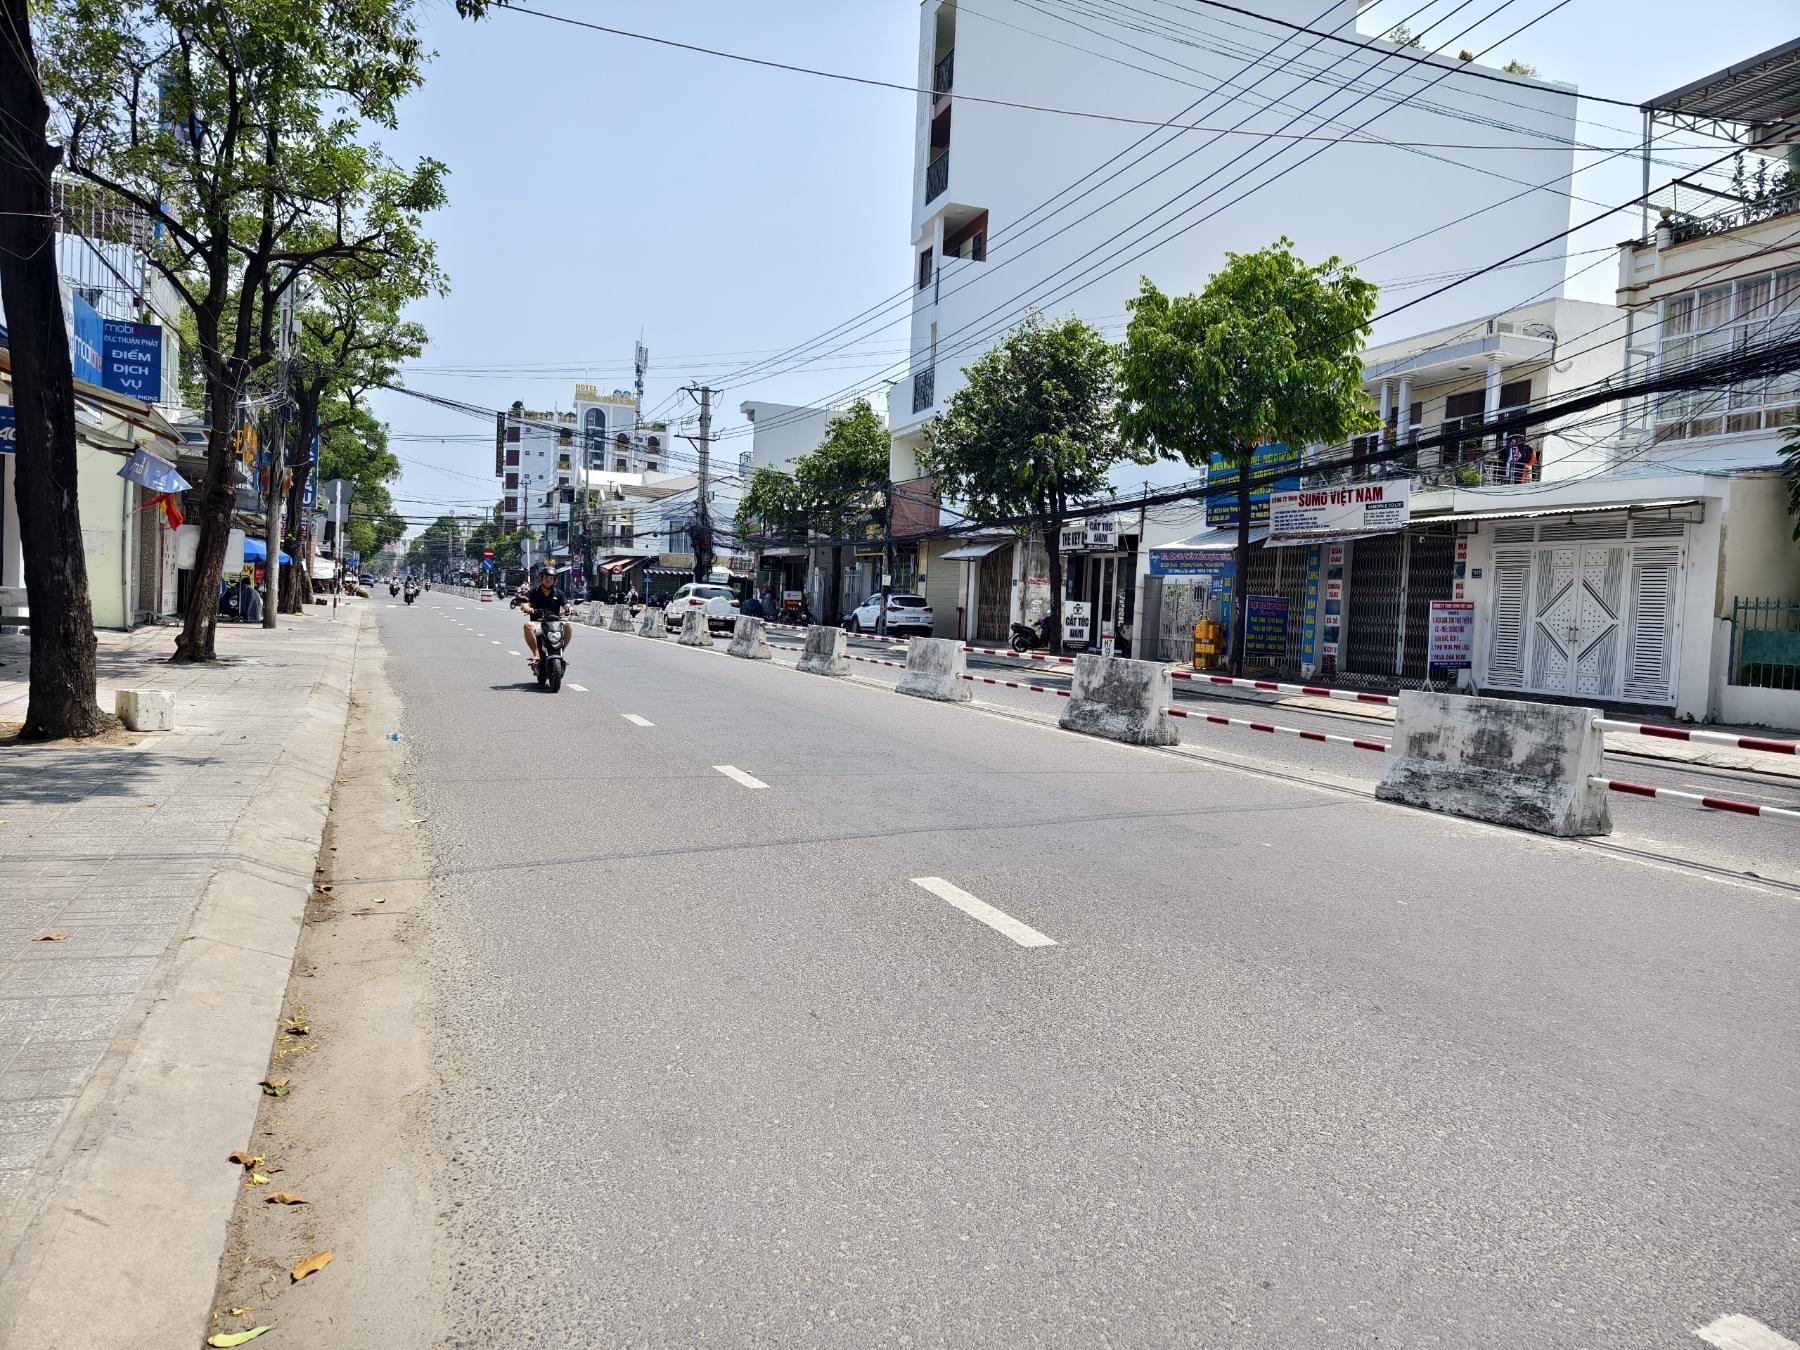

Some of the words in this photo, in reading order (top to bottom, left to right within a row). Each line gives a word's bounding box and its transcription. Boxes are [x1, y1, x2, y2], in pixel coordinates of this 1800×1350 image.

[113, 363, 149, 376] DỊCH
[120, 378, 142, 390] VỤ
[1330, 487, 1353, 506] VIỆT
[1359, 486, 1383, 502] NAM
[1089, 519, 1101, 531] CẮT
[1102, 520, 1113, 532] TÓC
[1062, 532, 1071, 546] THE
[1072, 532, 1081, 546] KEY
[1093, 533, 1108, 543] NAM
[1066, 614, 1077, 626] CẮT
[1077, 615, 1089, 627] TÓC
